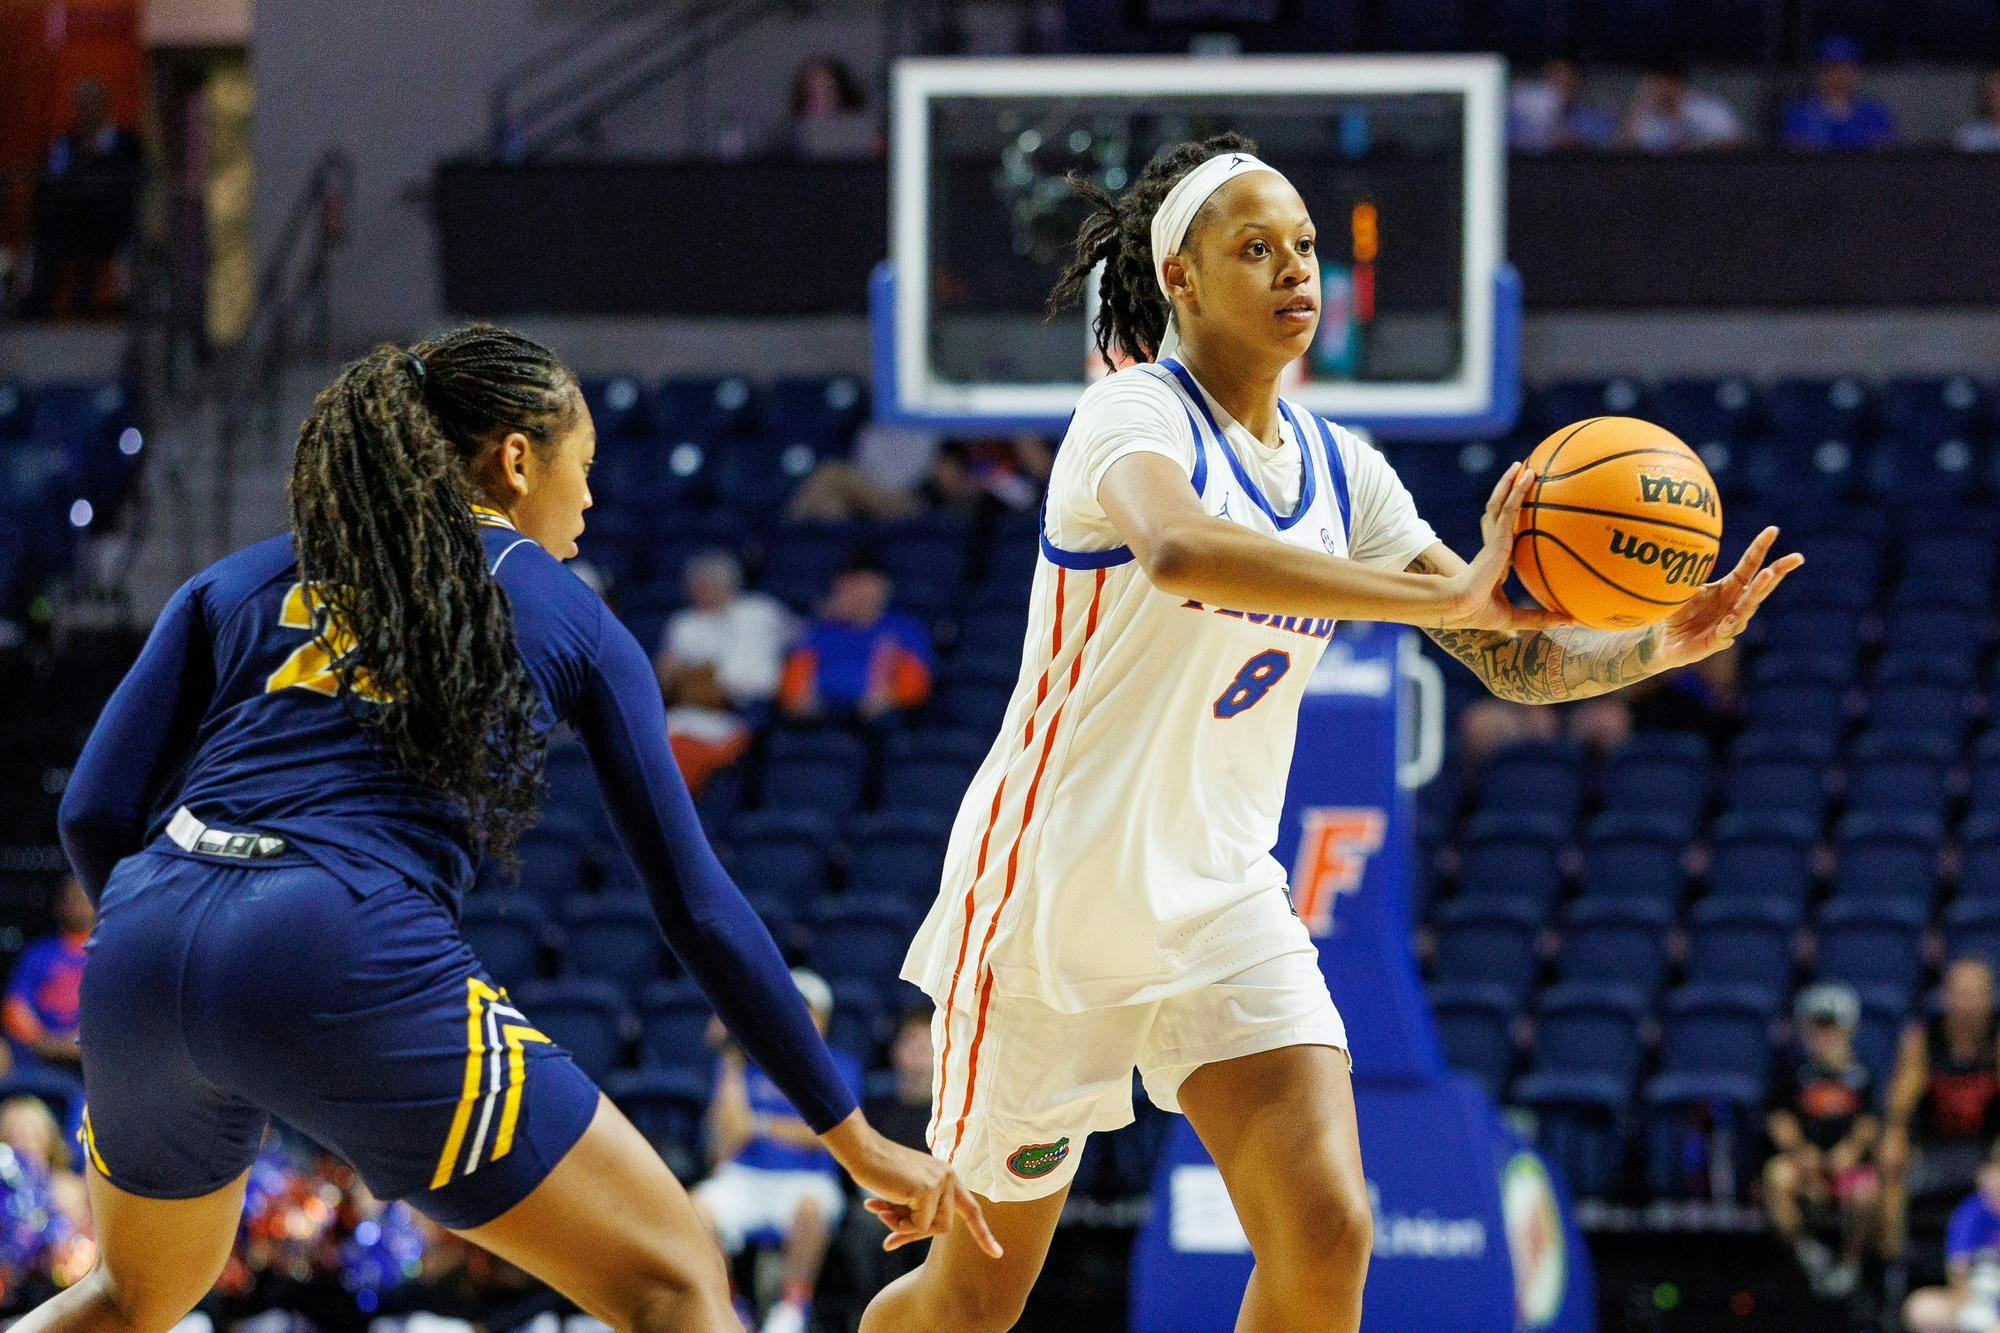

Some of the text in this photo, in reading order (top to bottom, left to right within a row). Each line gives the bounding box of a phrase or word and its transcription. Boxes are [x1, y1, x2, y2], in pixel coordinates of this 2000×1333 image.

[1639, 474, 1716, 518] NCAA
[1609, 528, 1715, 588] Wilson
[1213, 648, 1291, 718] 8
[1292, 806, 1388, 938] F
